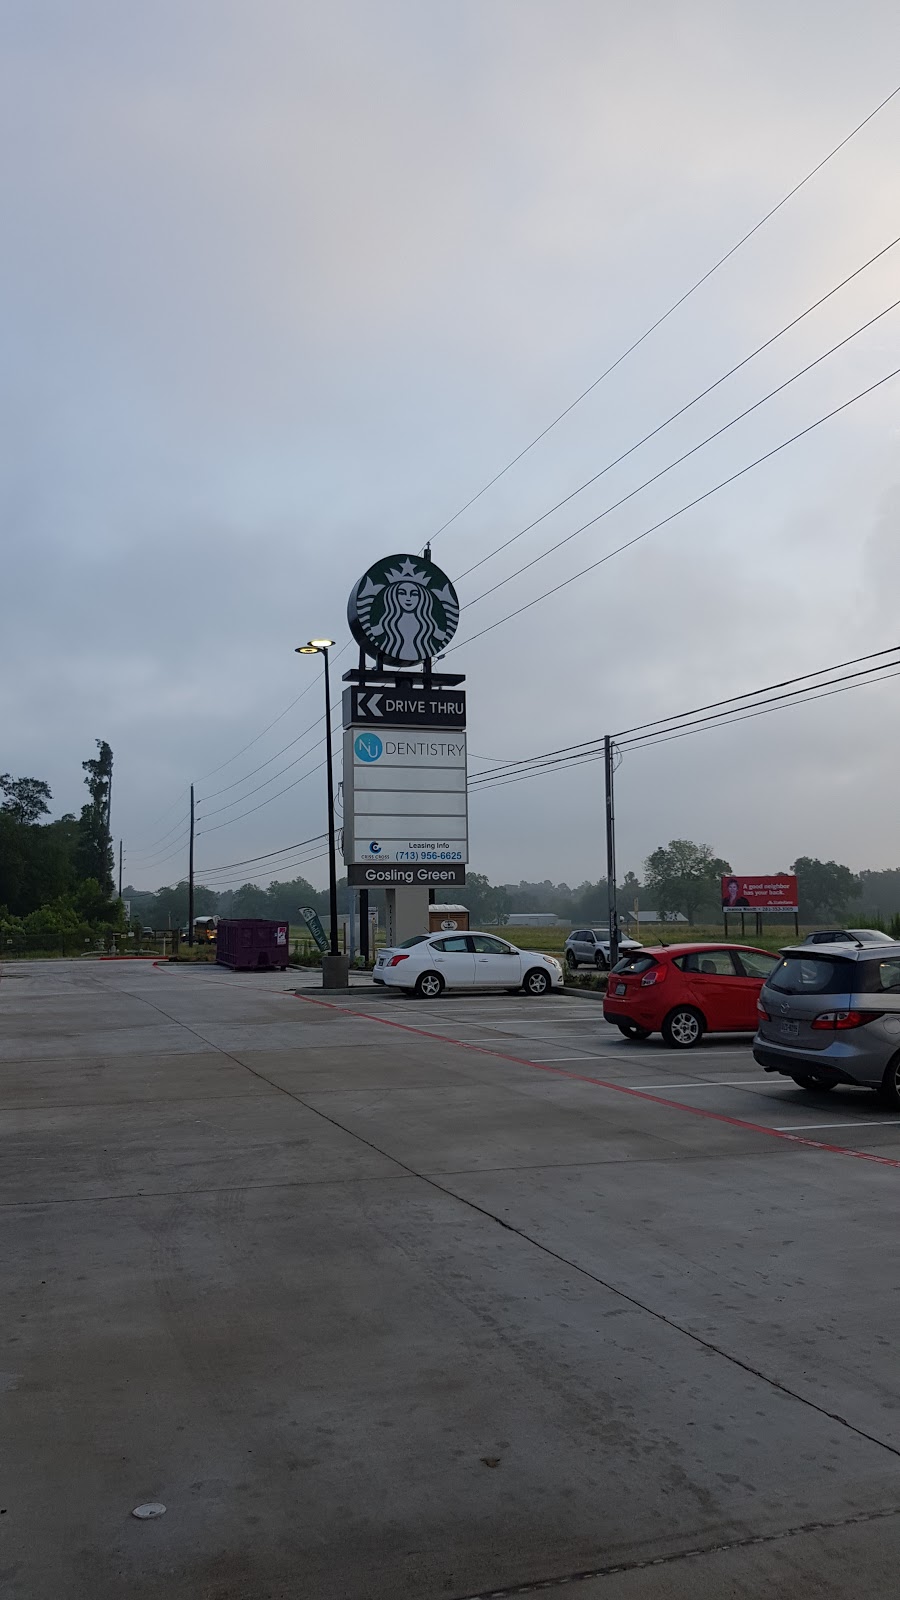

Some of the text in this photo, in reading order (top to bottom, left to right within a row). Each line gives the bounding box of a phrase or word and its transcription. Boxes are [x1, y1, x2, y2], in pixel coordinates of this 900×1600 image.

[385, 699, 464, 715] DRIVE THRU
[385, 741, 465, 756] DENTISTRY
[409, 842, 435, 850] Leasing
[395, 851, 462, 861] (713) 956-6625
[365, 869, 456, 883] Gosling Green
